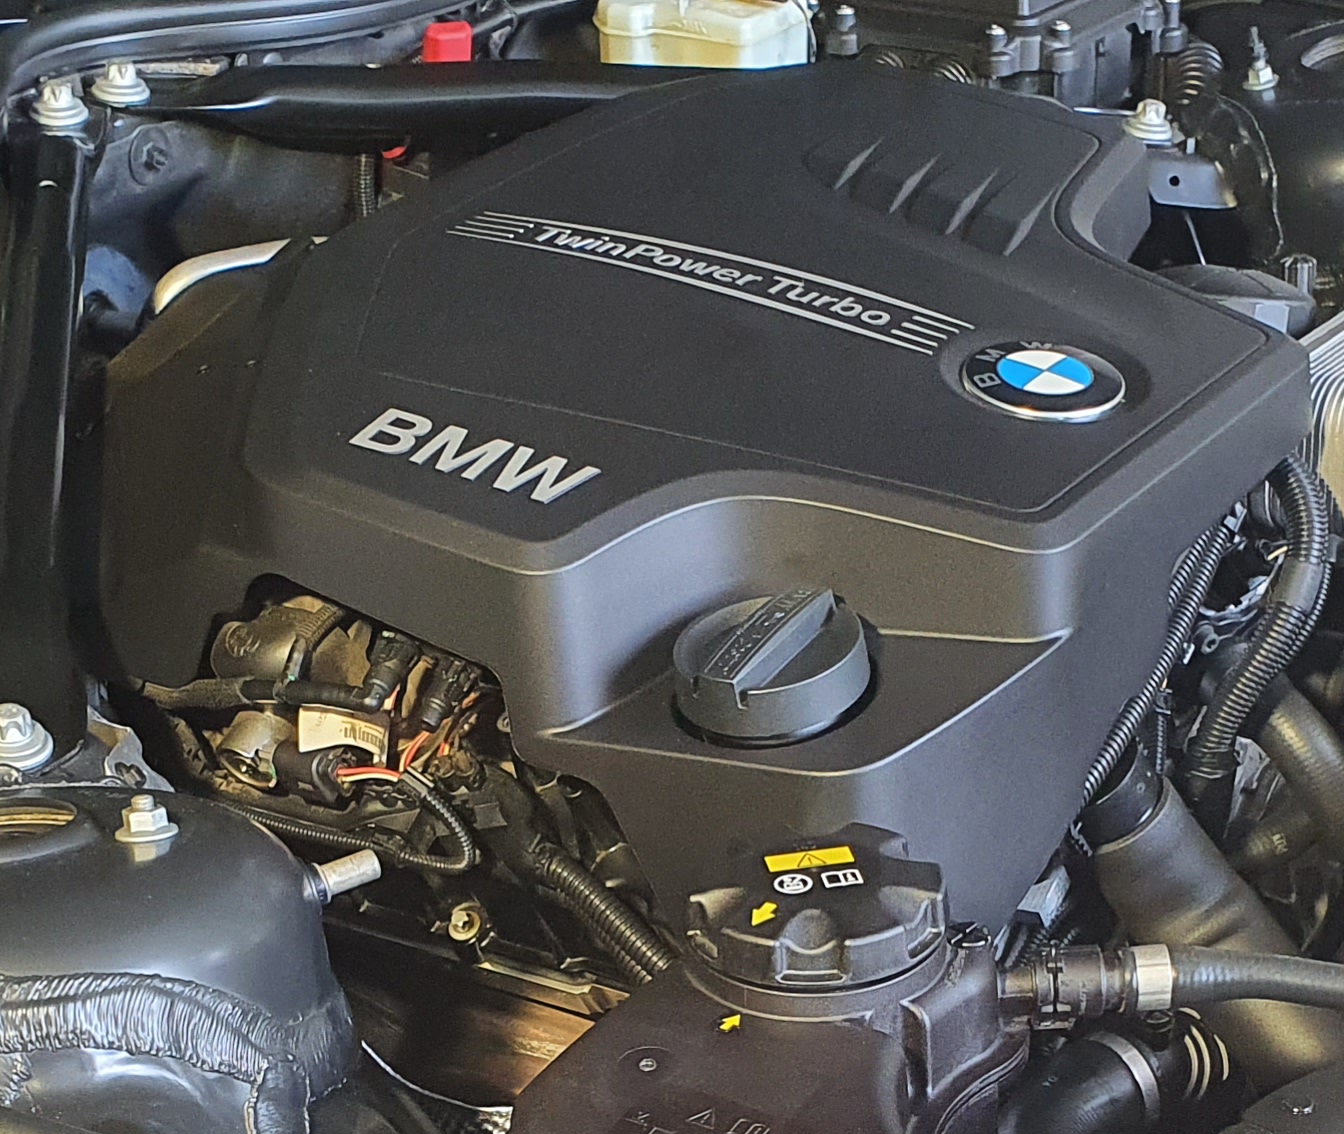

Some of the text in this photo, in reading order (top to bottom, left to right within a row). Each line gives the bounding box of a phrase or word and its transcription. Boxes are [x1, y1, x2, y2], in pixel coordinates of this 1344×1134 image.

[534, 225, 891, 326] TwinPower Turbo
[973, 340, 1053, 389] BMW
[349, 408, 602, 504] BMW
